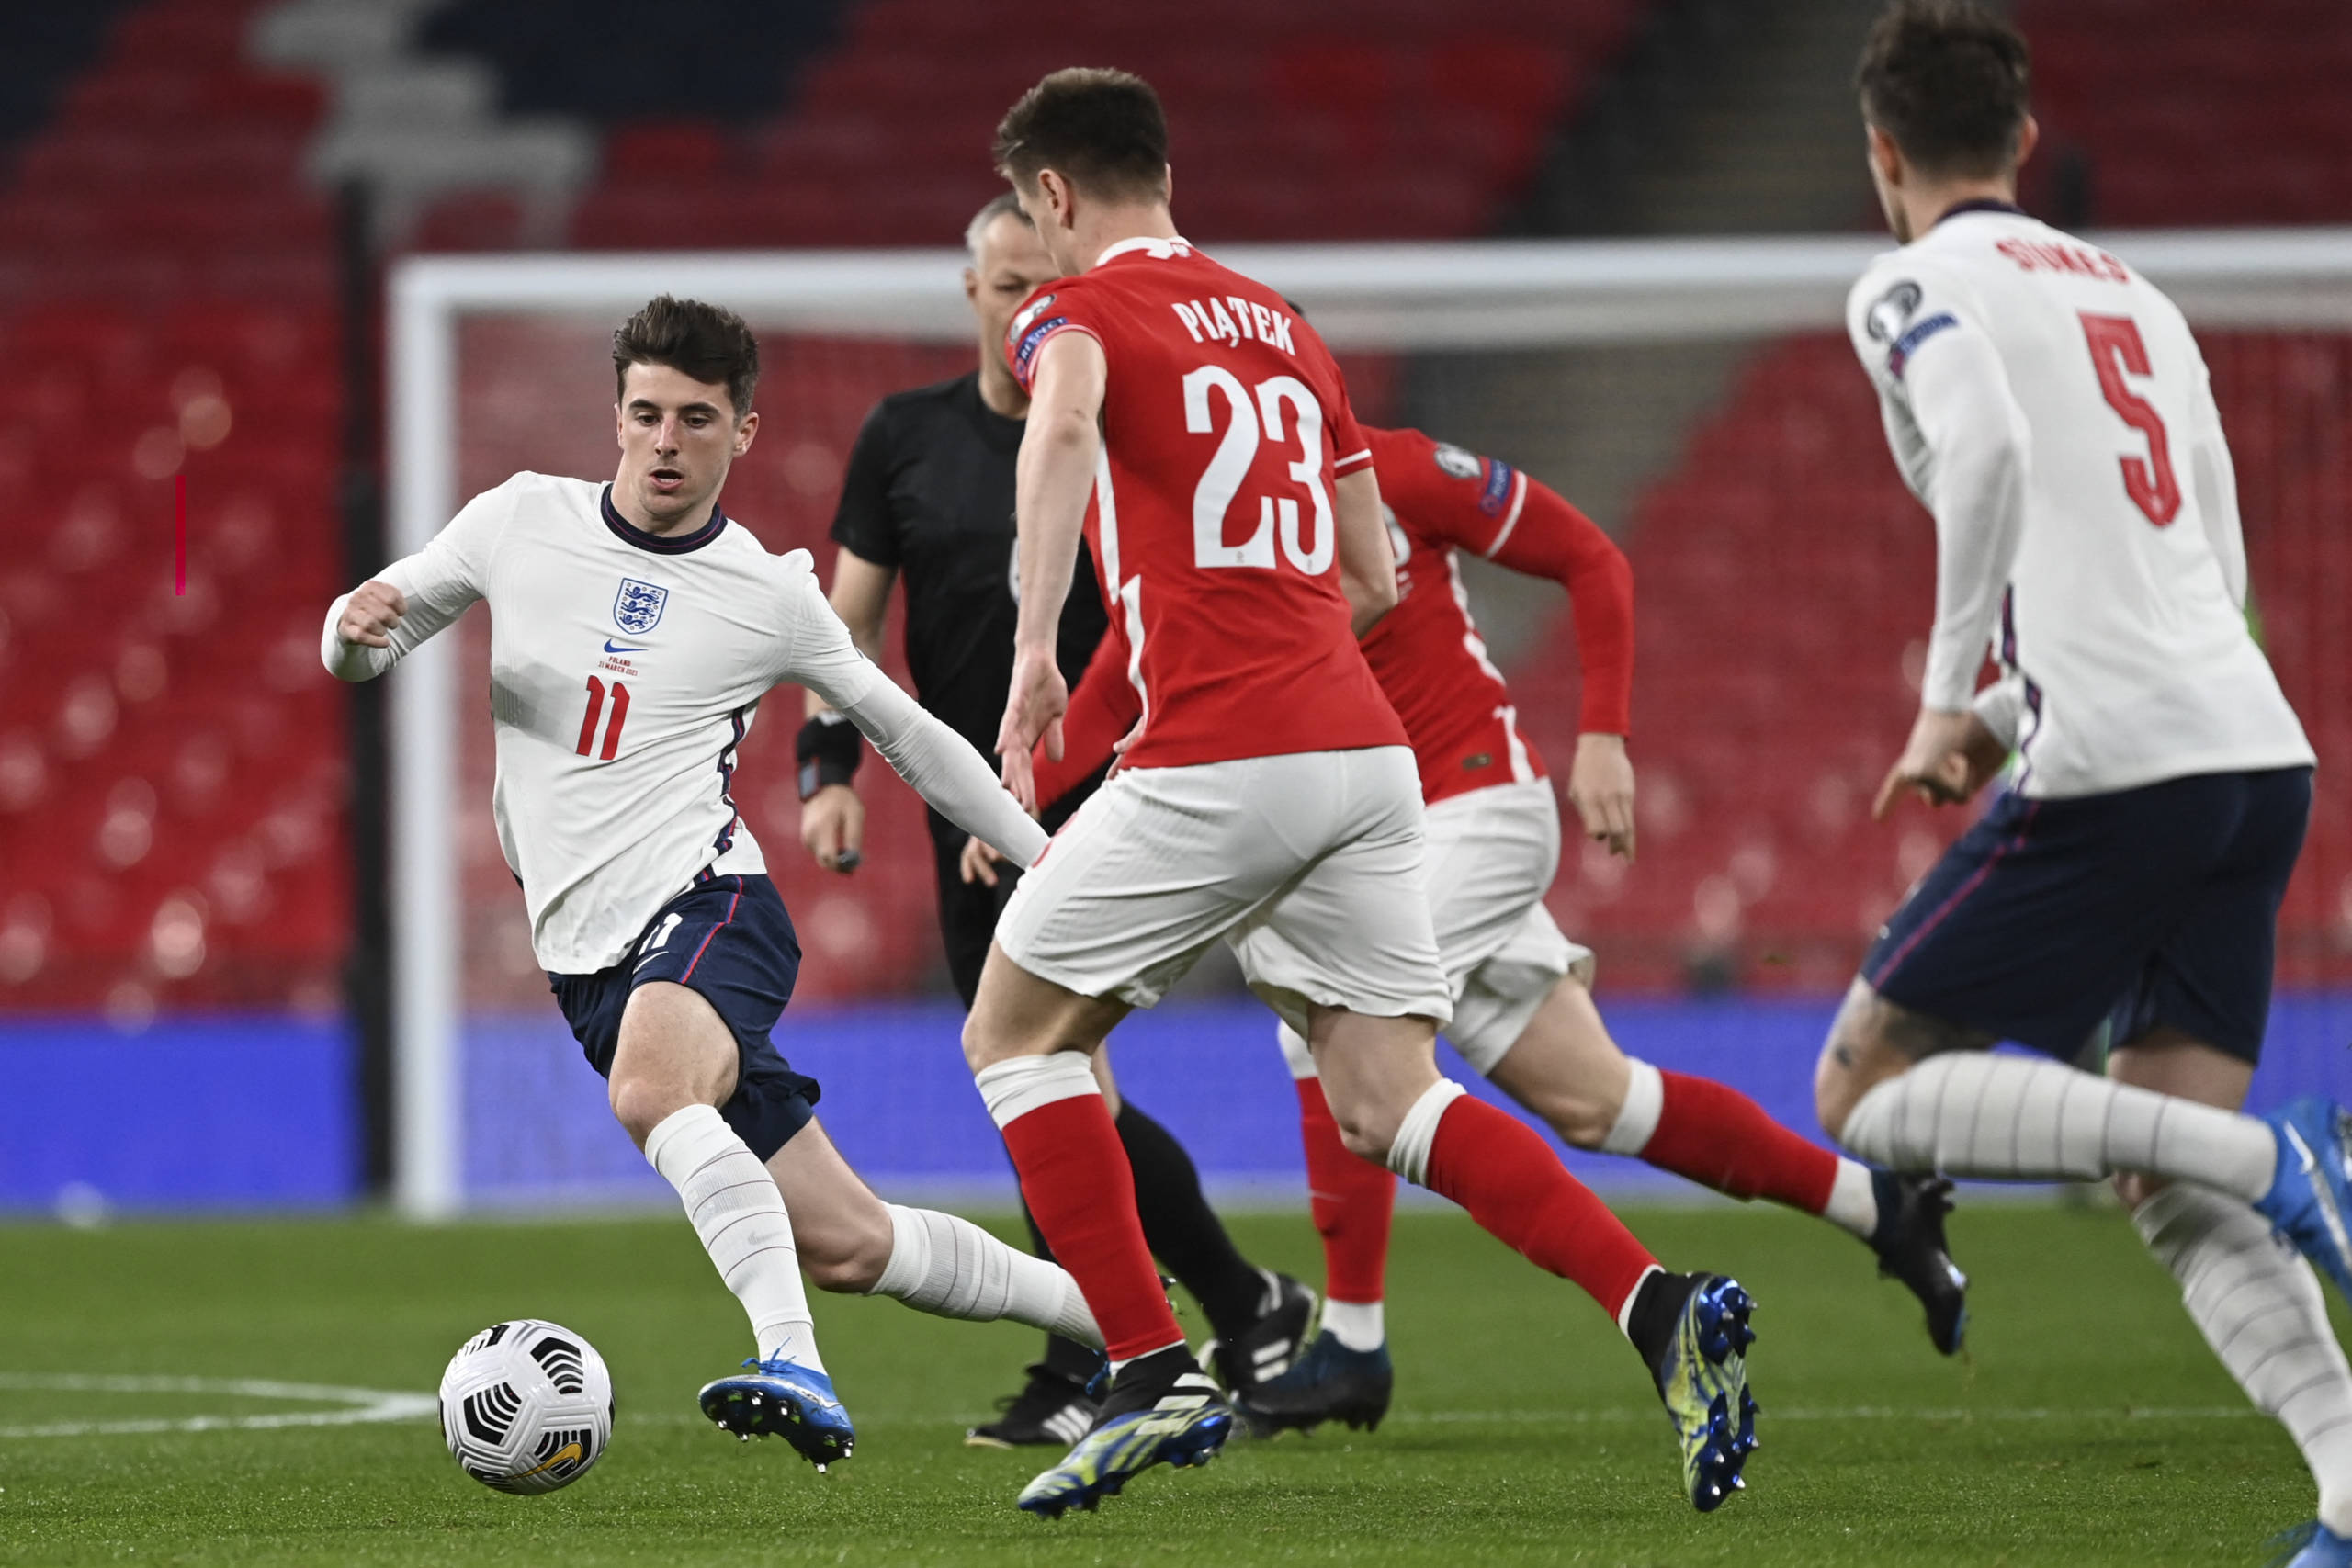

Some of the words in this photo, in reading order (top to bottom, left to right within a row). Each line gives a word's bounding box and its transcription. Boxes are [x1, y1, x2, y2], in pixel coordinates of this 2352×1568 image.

[1171, 297, 1295, 355] PIĄTEK
[1182, 365, 1335, 575] 23
[2076, 310, 2182, 528] 5
[575, 674, 630, 760] 11
